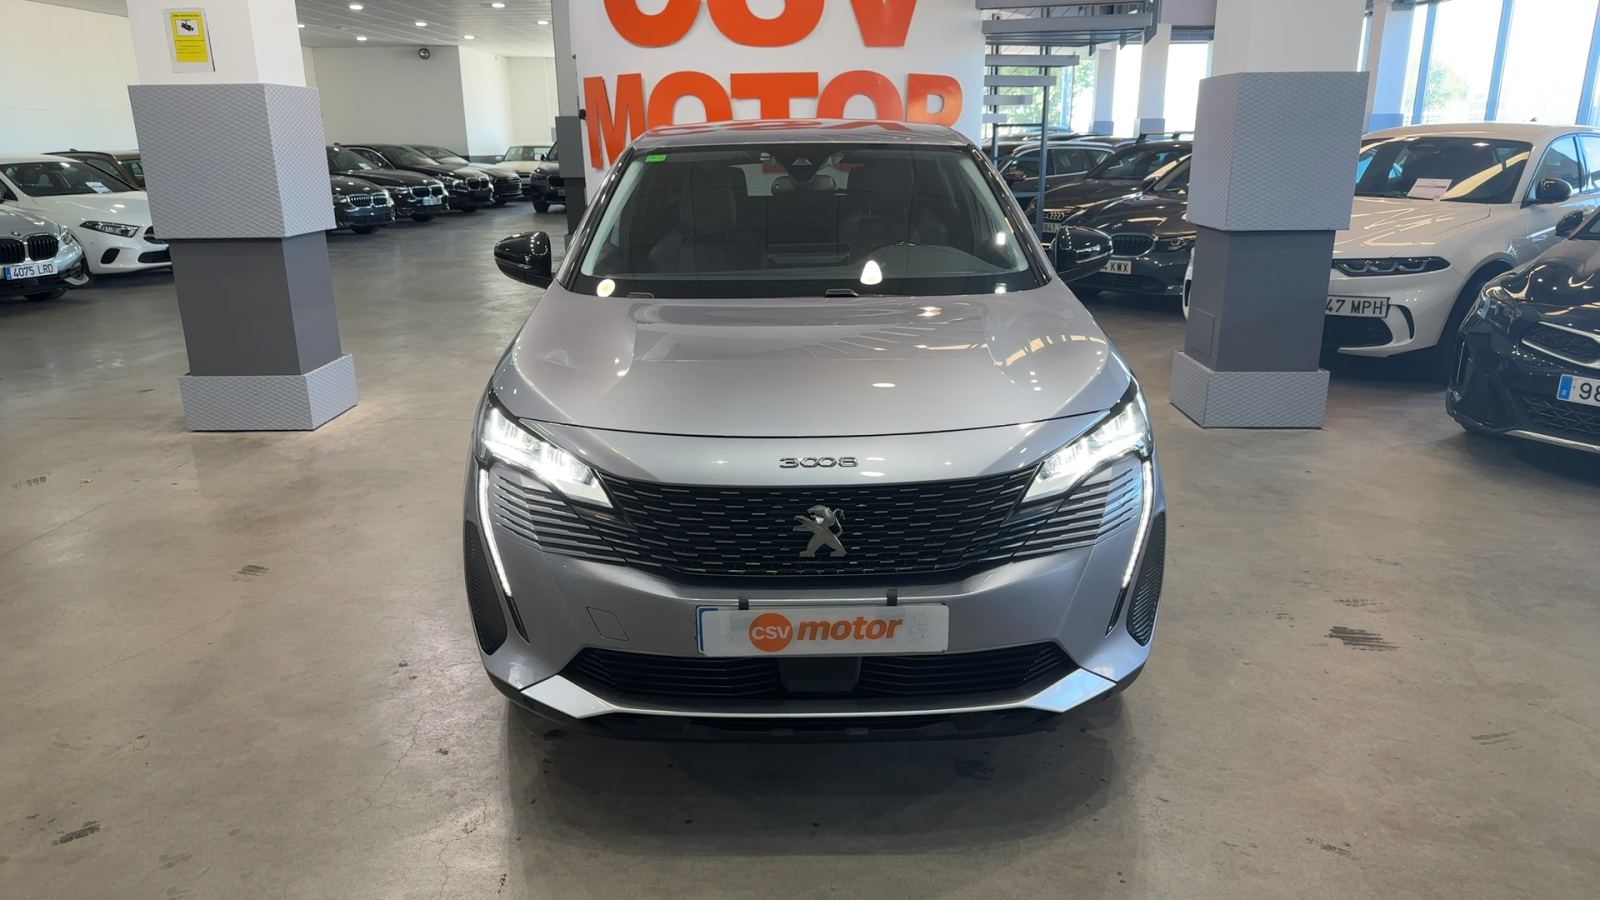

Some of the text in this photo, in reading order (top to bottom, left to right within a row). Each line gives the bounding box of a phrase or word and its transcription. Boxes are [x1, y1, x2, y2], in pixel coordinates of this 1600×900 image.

[13, 263, 54, 277] 4075 LRD
[1350, 300, 1384, 315] MPH
[779, 457, 858, 468] 3008
[751, 616, 903, 641] CSV motor
